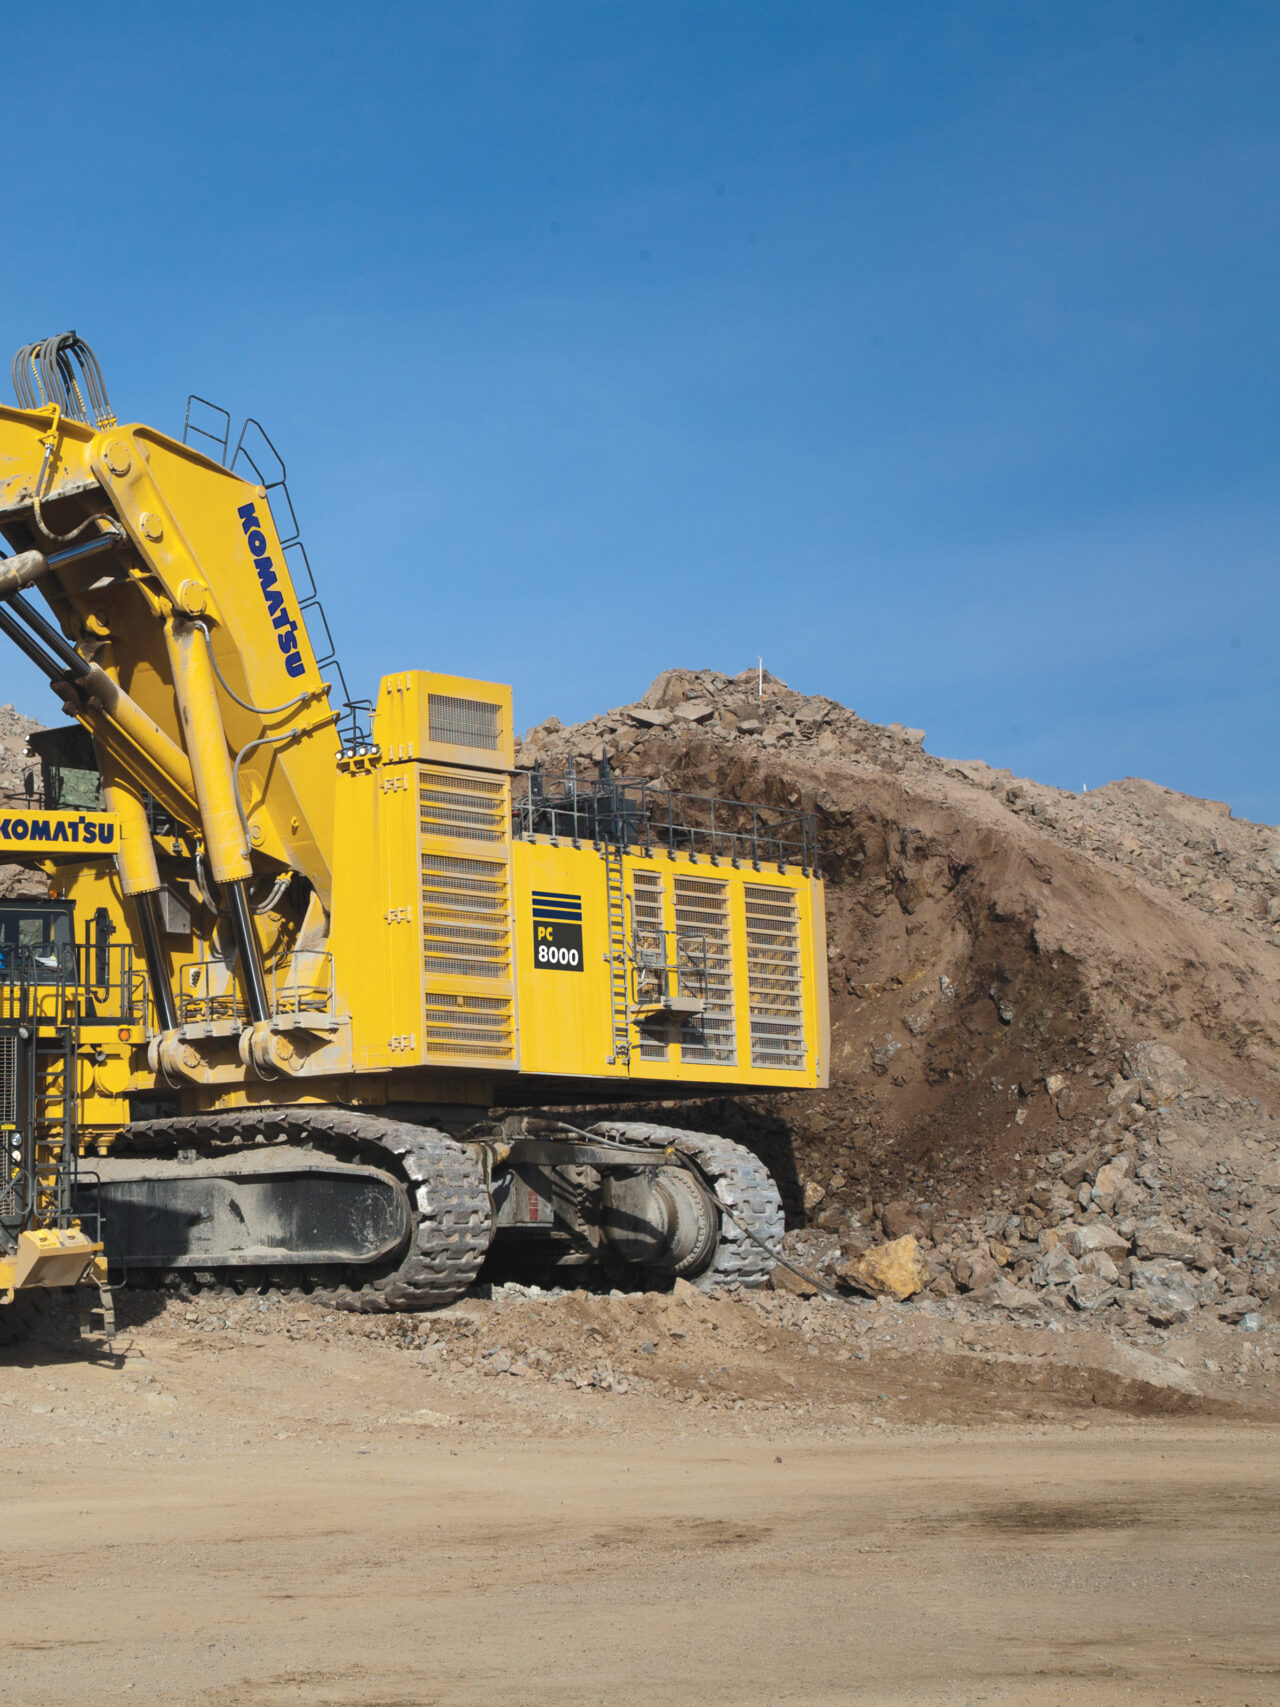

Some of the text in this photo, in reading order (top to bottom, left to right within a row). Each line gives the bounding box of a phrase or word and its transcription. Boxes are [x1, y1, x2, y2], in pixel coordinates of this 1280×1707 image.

[237, 502, 306, 678] KOMATSU
[537, 926, 553, 941] PC
[538, 945, 579, 966] 8000
